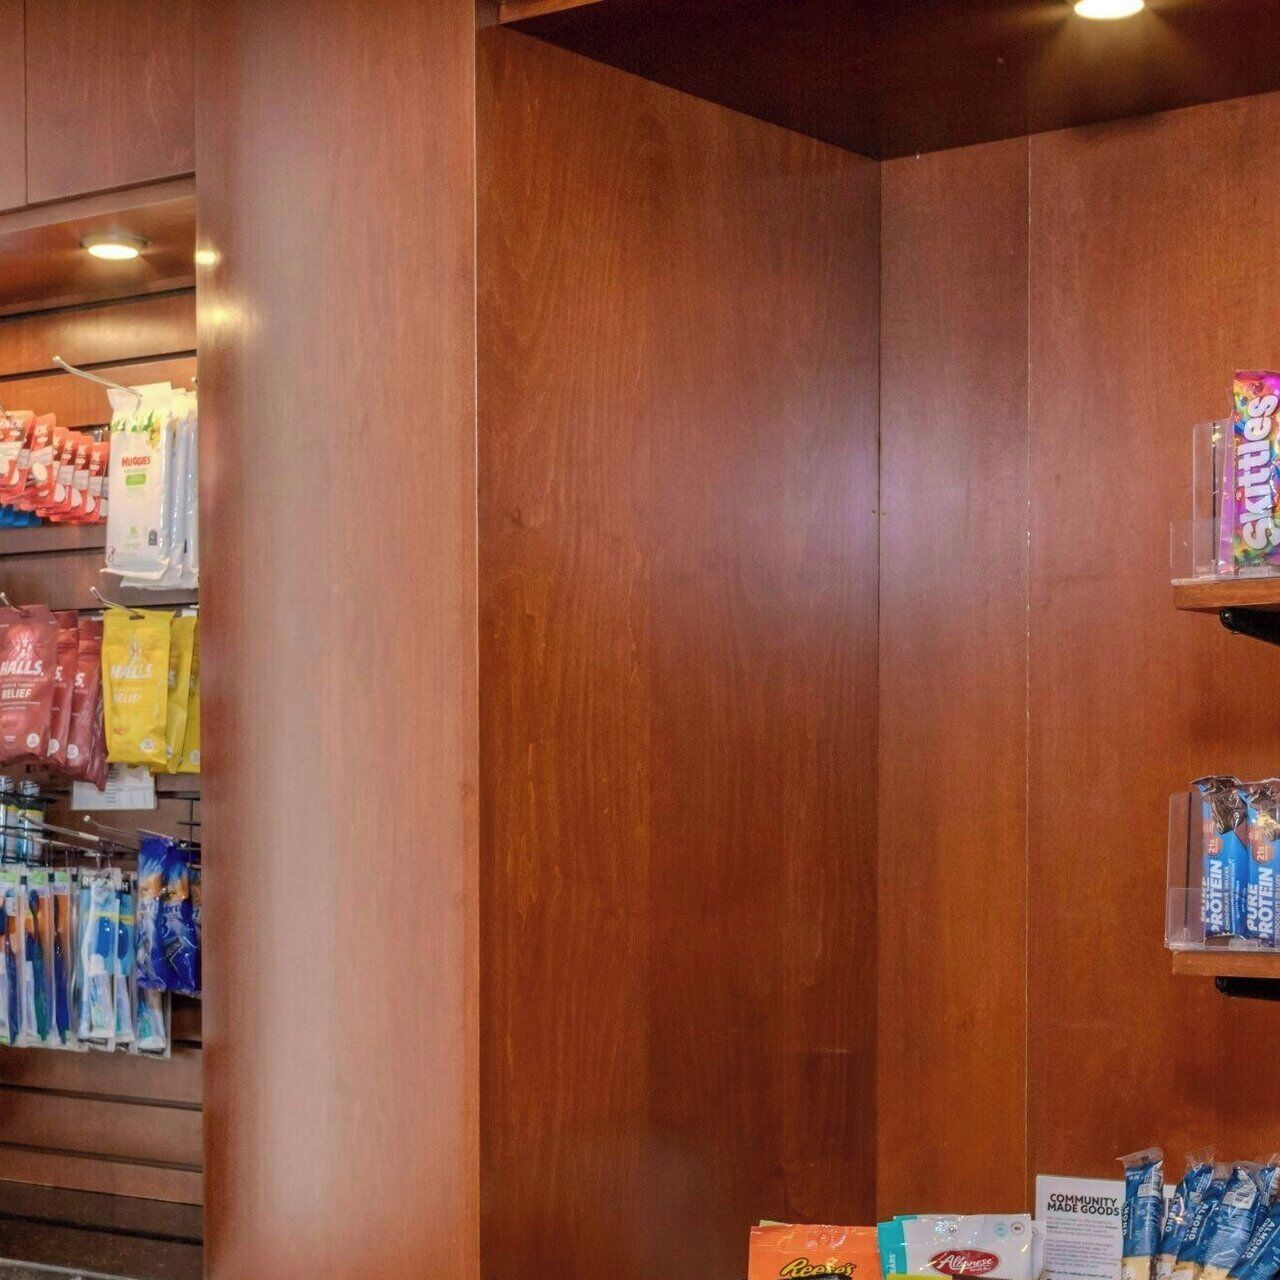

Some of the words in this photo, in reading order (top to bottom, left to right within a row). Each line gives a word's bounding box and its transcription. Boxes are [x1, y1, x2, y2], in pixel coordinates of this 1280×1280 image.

[121, 456, 151, 467] HUGGIES
[1, 688, 33, 699] RELIEF
[1247, 883, 1258, 931] PURE
[1050, 1193, 1118, 1208] COMMUNITY
[1047, 1202, 1078, 1213] MADE
[1080, 1205, 1120, 1217] GOODS
[1246, 1221, 1276, 1260] ALMOND
